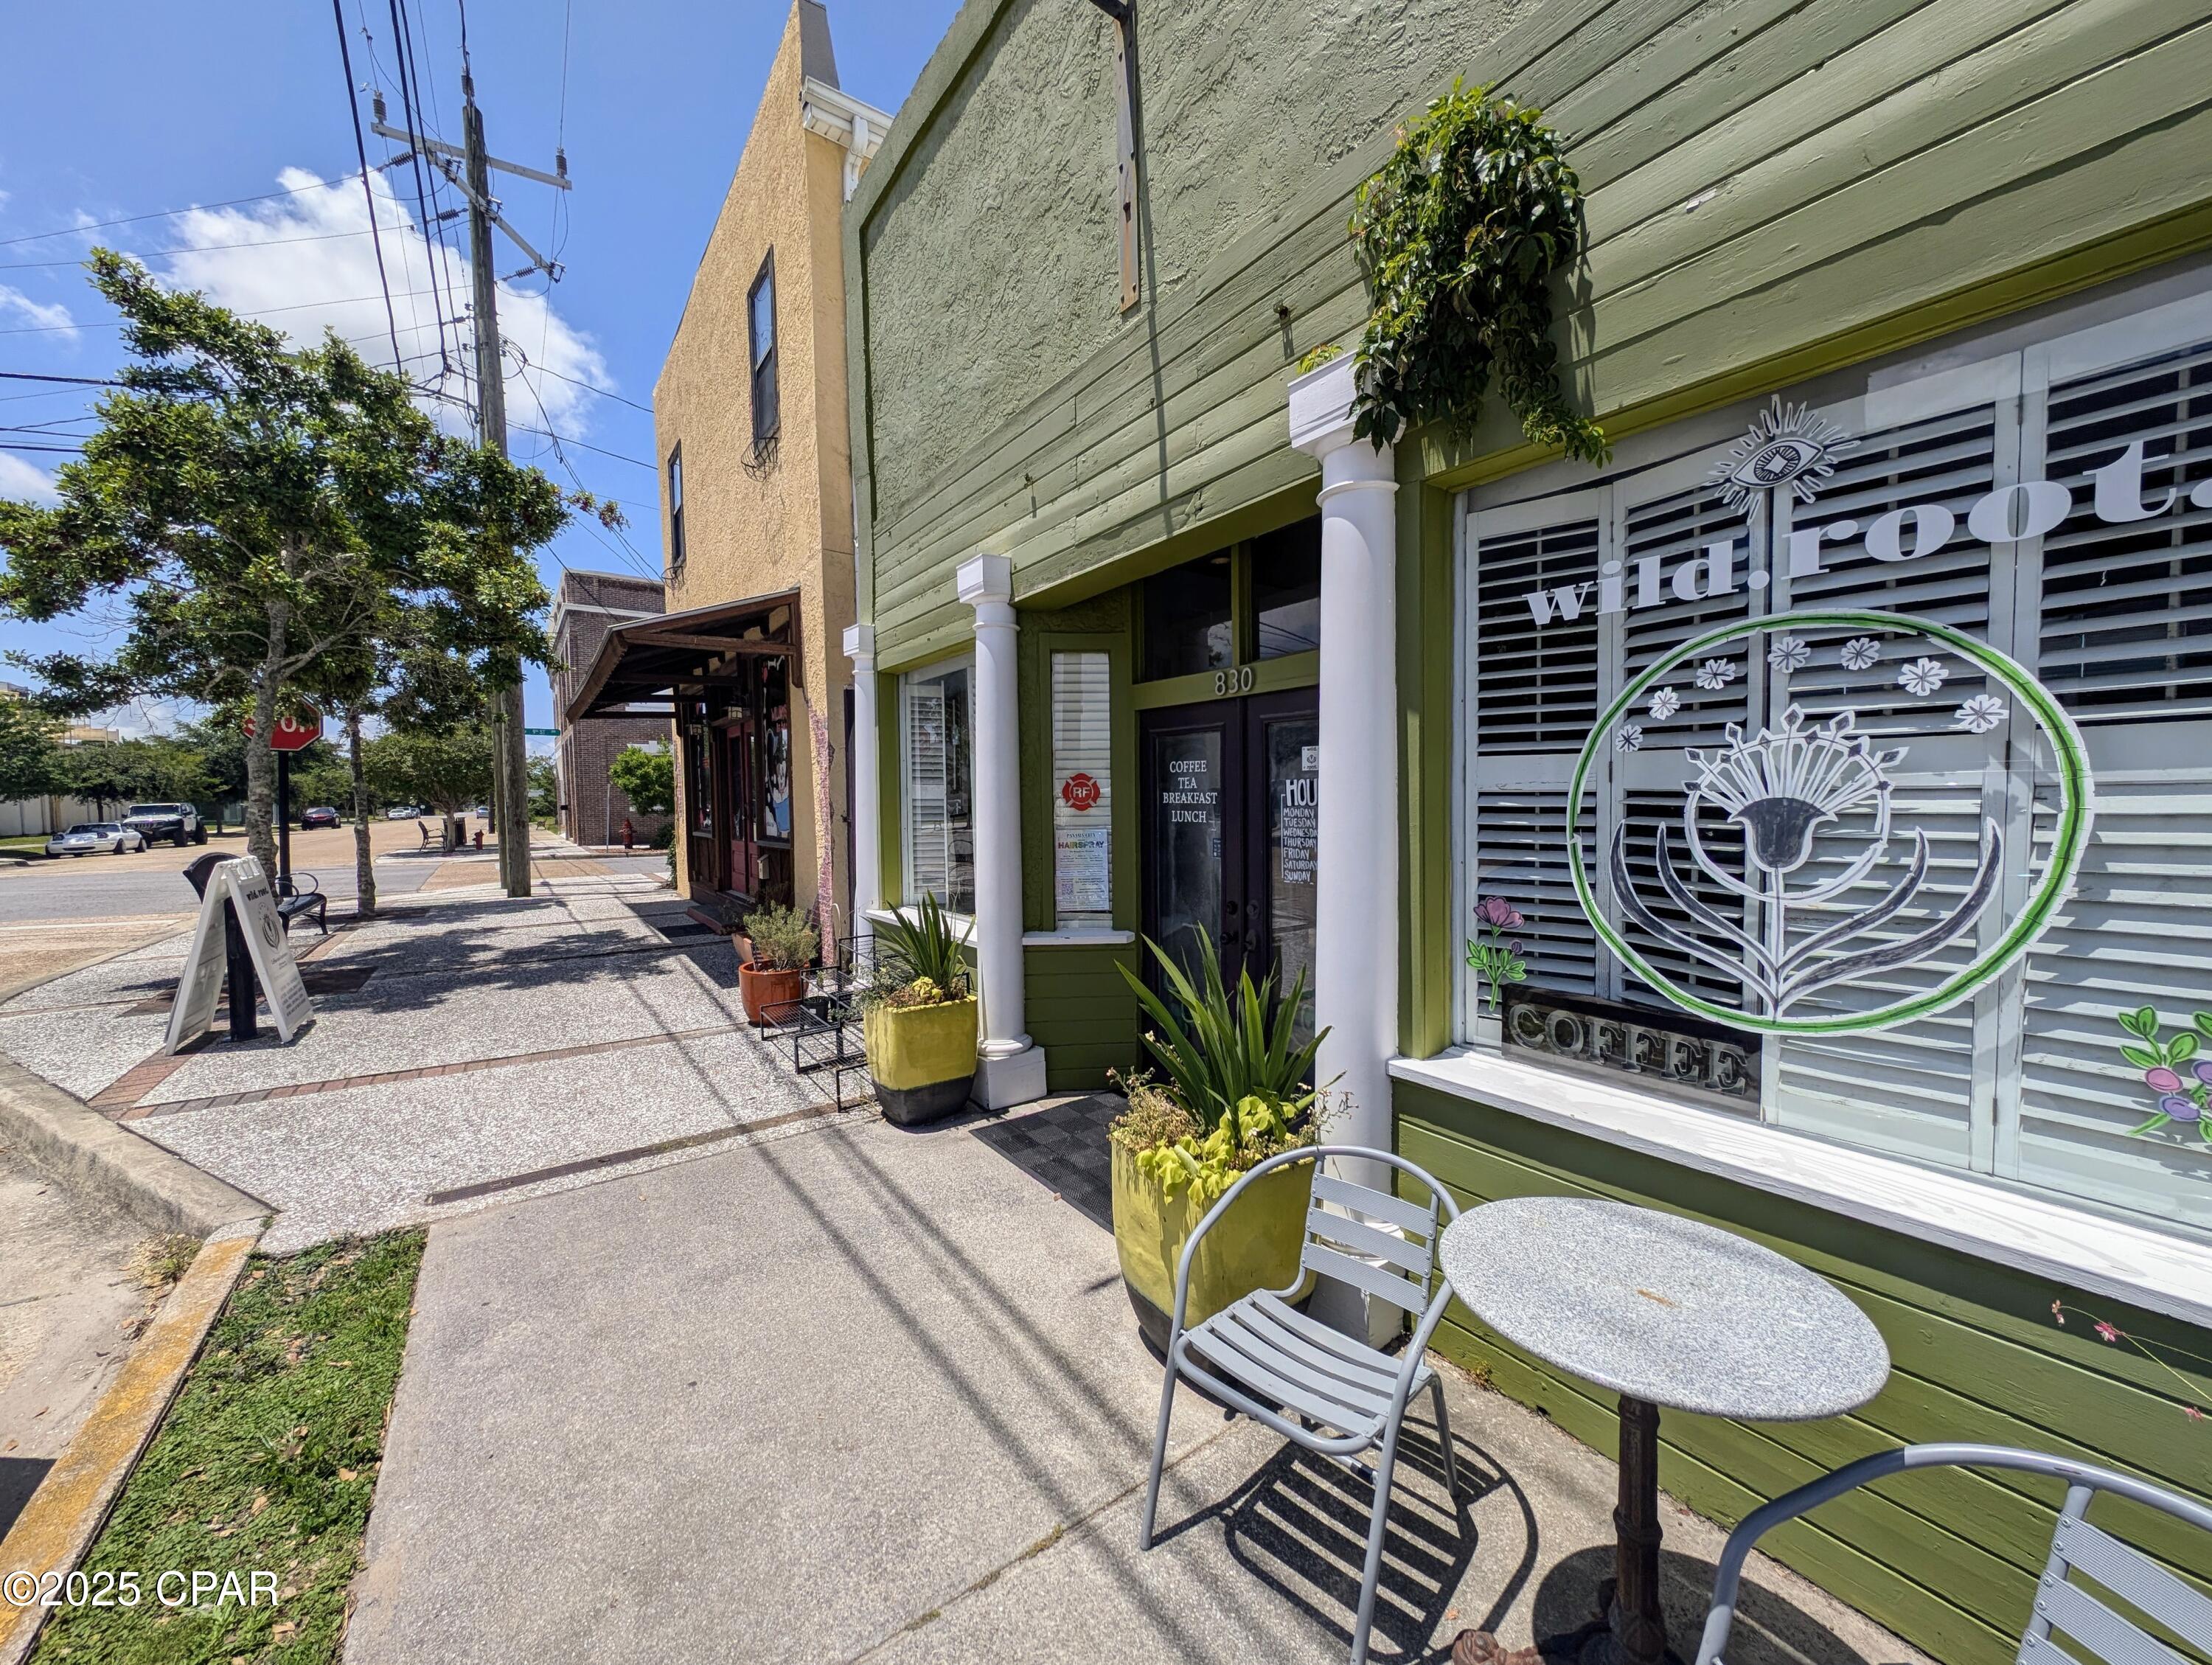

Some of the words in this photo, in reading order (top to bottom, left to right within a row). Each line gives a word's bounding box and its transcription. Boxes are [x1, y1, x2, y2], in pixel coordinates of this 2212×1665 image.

[1215, 667, 1252, 696] 830
[1169, 760, 1207, 773] COFFEE
[1178, 776, 1197, 789] TEA
[1073, 787, 1091, 798] RF
[1162, 792, 1217, 804] BREAKFAST
[1171, 810, 1207, 823] LUNCH
[1283, 807, 1315, 818] MONDAY
[1283, 818, 1316, 828] TUESDAY
[1057, 841, 1105, 849] HAIRSPRAY
[1283, 836, 1317, 852] THURSDAY
[1283, 847, 1310, 861] FRIDAY
[1284, 858, 1318, 871] SATURDAY
[1284, 870, 1311, 882] SUNDAY
[1509, 1004, 1747, 1096] COFFEE
